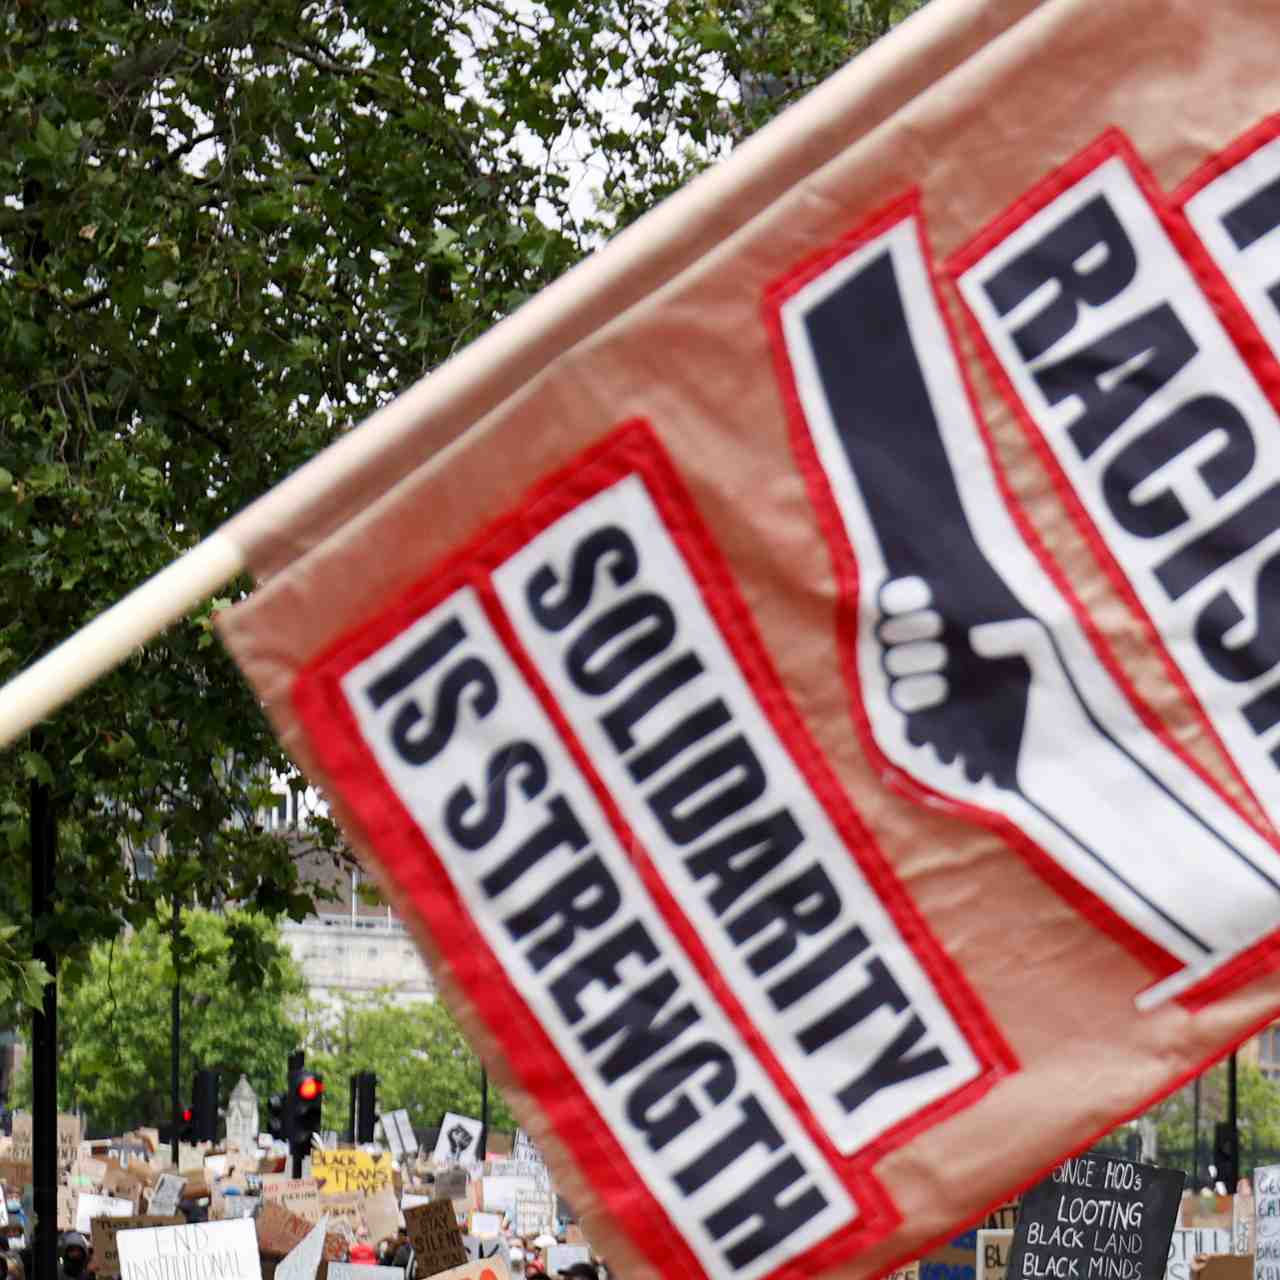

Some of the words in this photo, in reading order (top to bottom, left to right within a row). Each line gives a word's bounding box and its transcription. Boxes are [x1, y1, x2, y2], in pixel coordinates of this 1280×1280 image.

[523, 525, 950, 1116] SOLIDARITY
[366, 618, 499, 768] IS
[443, 740, 829, 1272] STRENGTH
[1057, 1195, 1144, 1230] LOOTING
[154, 1223, 208, 1256] END
[1027, 1222, 1084, 1249] BLACK
[1094, 1231, 1144, 1254] LAND
[1022, 1253, 1080, 1277] BLACK
